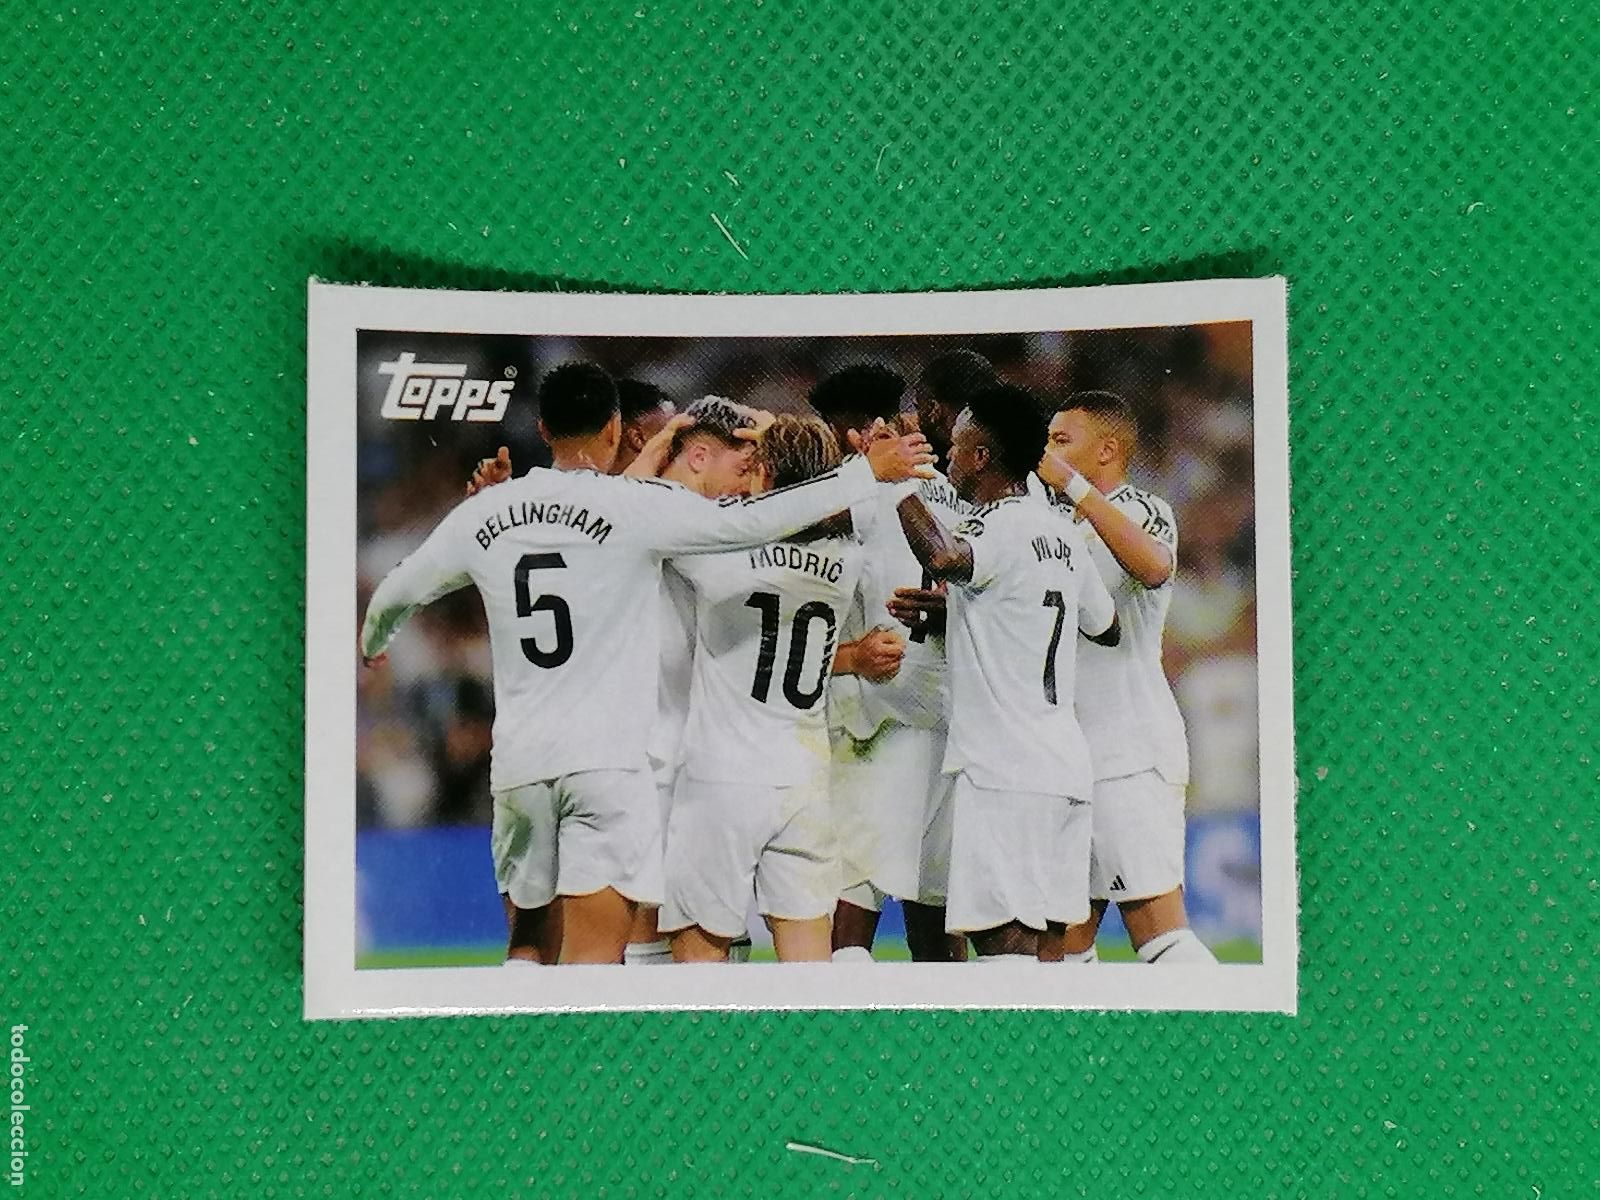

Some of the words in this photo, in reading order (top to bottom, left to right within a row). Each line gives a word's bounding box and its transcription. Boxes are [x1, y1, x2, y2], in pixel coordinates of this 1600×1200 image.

[475, 502, 613, 551] BELLINGHAM
[514, 552, 574, 669] 5
[744, 591, 835, 710] 10
[1042, 589, 1067, 706] 7
